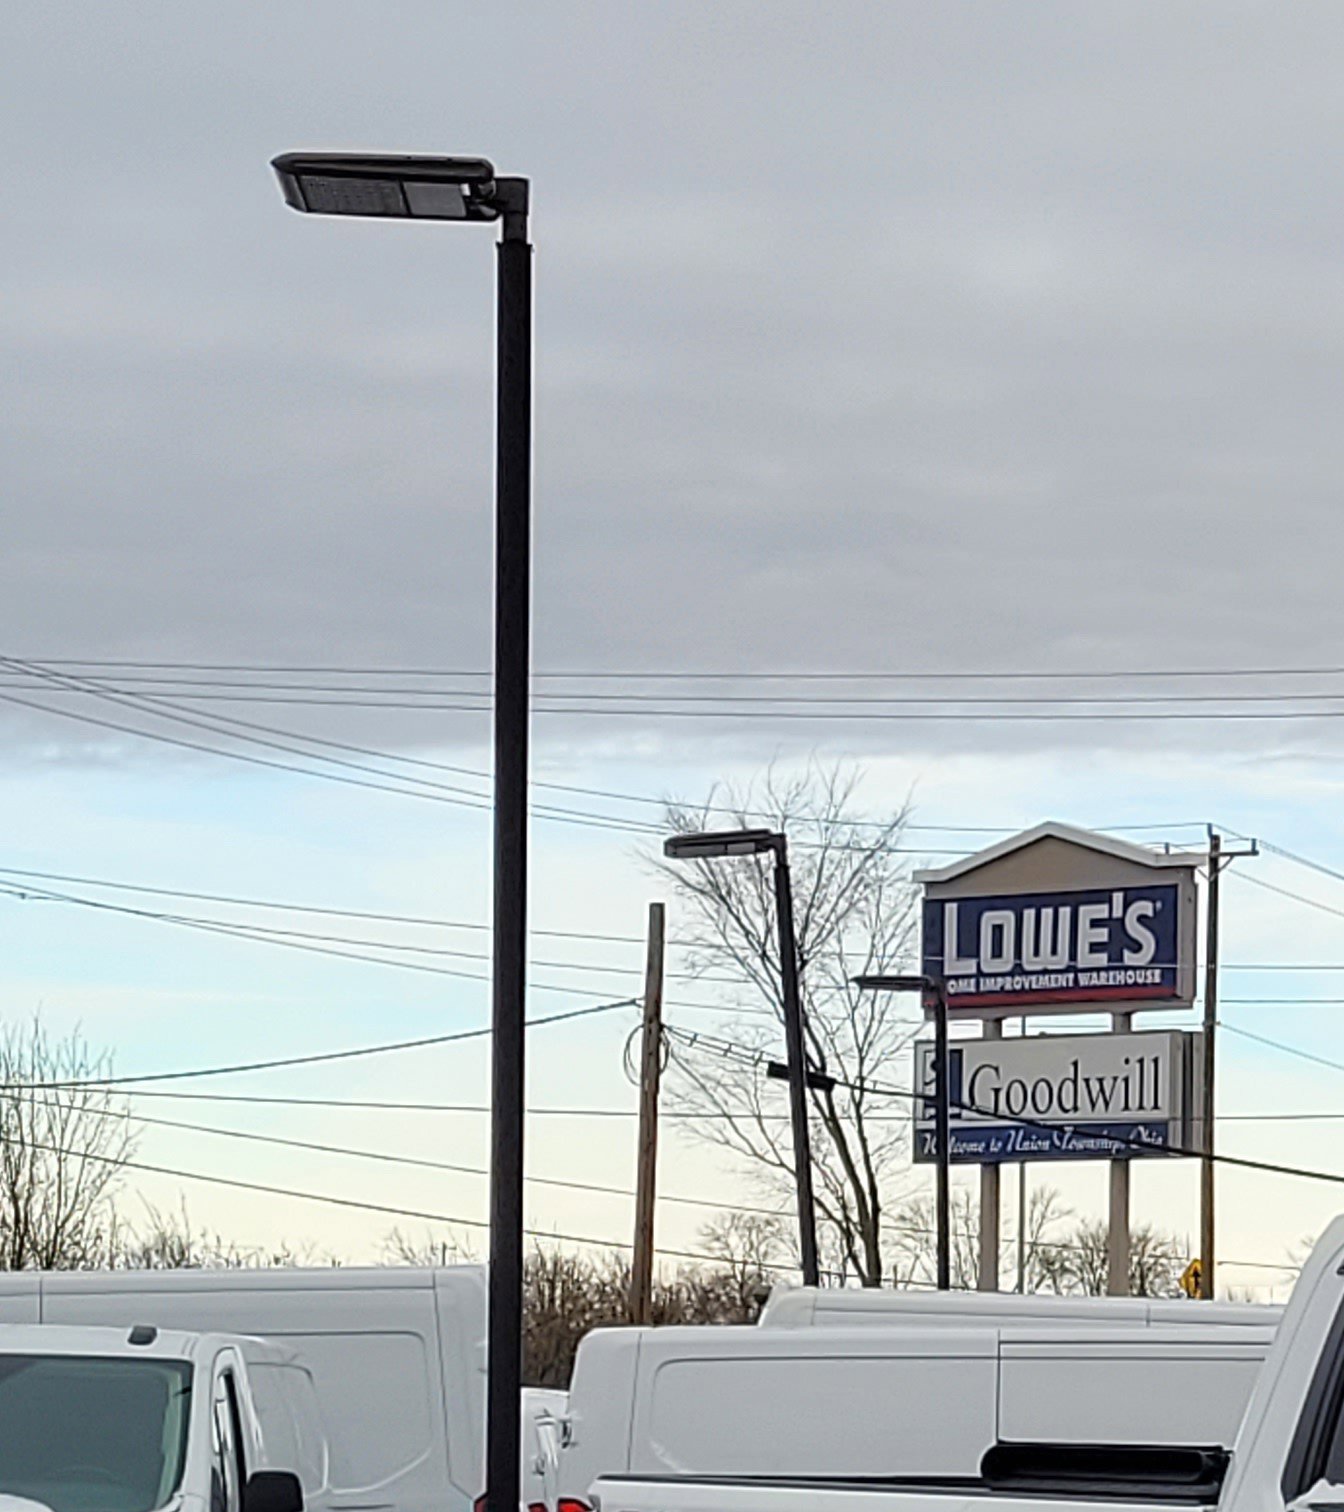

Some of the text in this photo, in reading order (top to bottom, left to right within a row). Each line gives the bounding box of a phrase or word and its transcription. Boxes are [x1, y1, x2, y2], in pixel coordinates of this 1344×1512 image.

[944, 891, 1157, 975] LOWE'S
[948, 968, 1161, 995] OME IMPROVEMENT WAREHOUSE
[968, 1056, 1162, 1116] Goodwill
[923, 1132, 986, 1155] Wlcome
[990, 1136, 1003, 1152] to
[1006, 1128, 1051, 1153] Union
